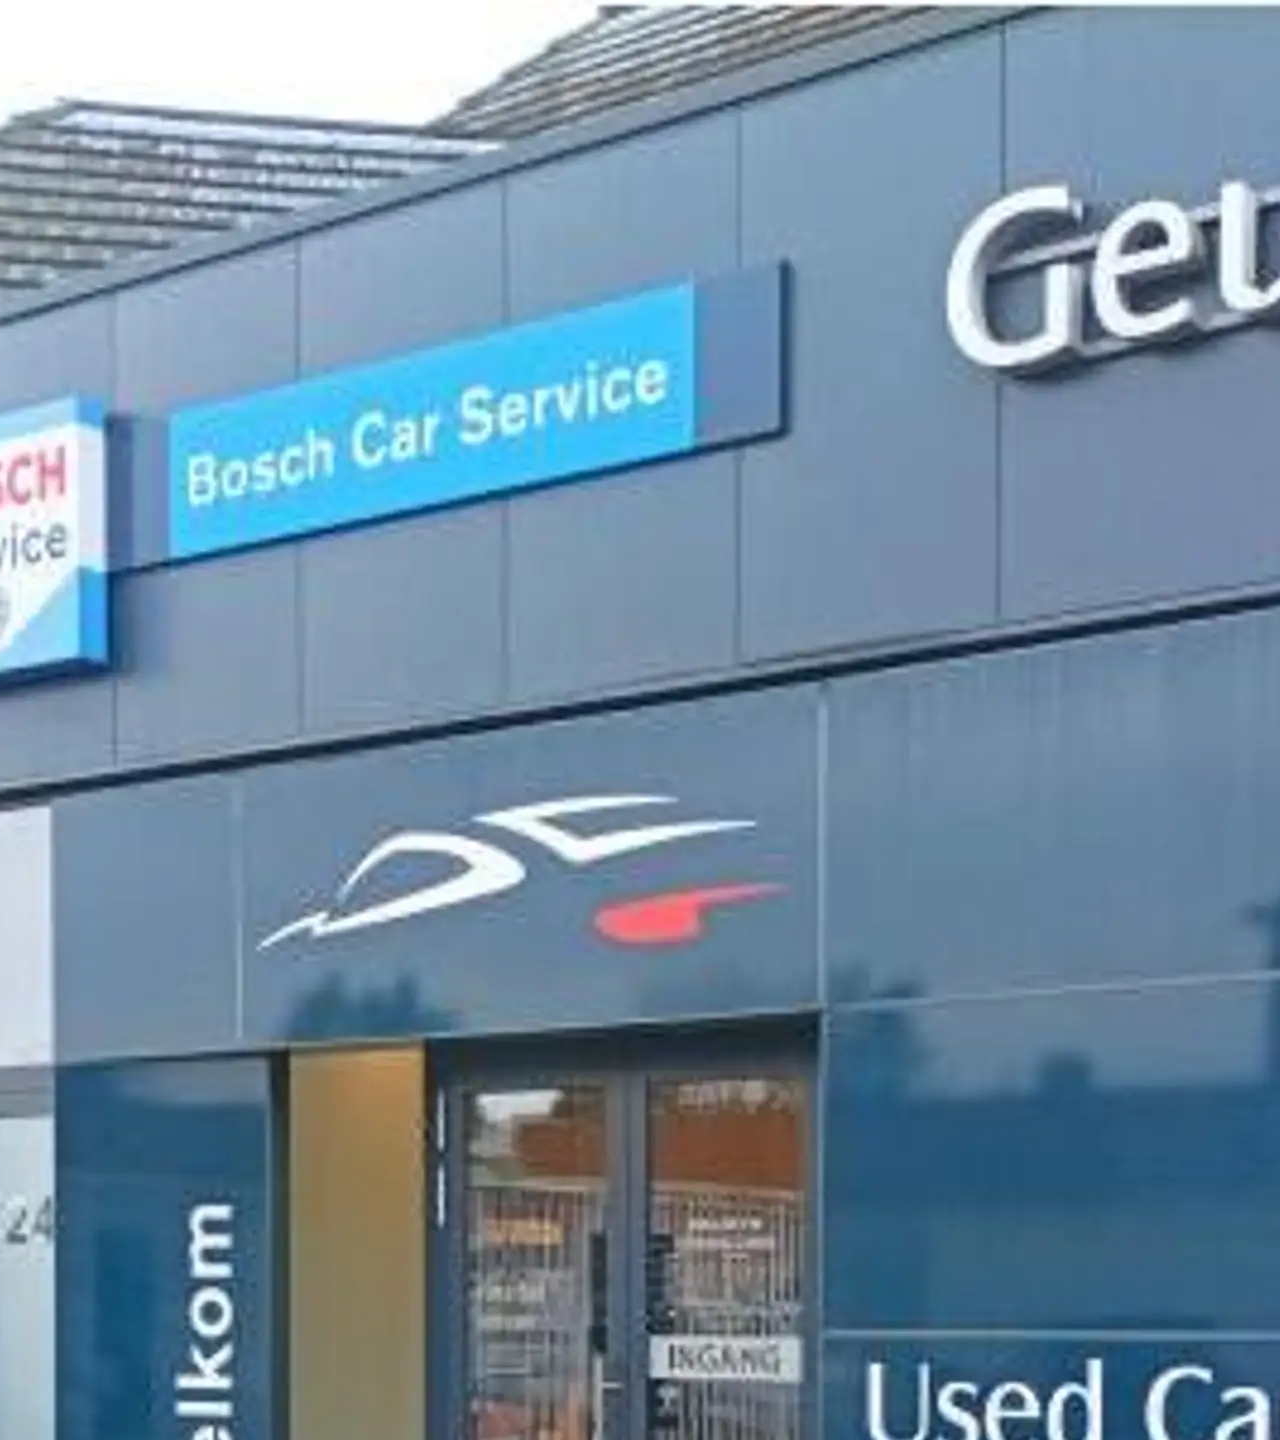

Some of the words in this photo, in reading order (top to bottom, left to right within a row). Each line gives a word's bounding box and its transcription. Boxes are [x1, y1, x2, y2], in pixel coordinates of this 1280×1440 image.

[186, 424, 334, 507] Bosch
[351, 411, 442, 470] Car
[458, 356, 668, 447] Service
[668, 1342, 782, 1376] INGANG
